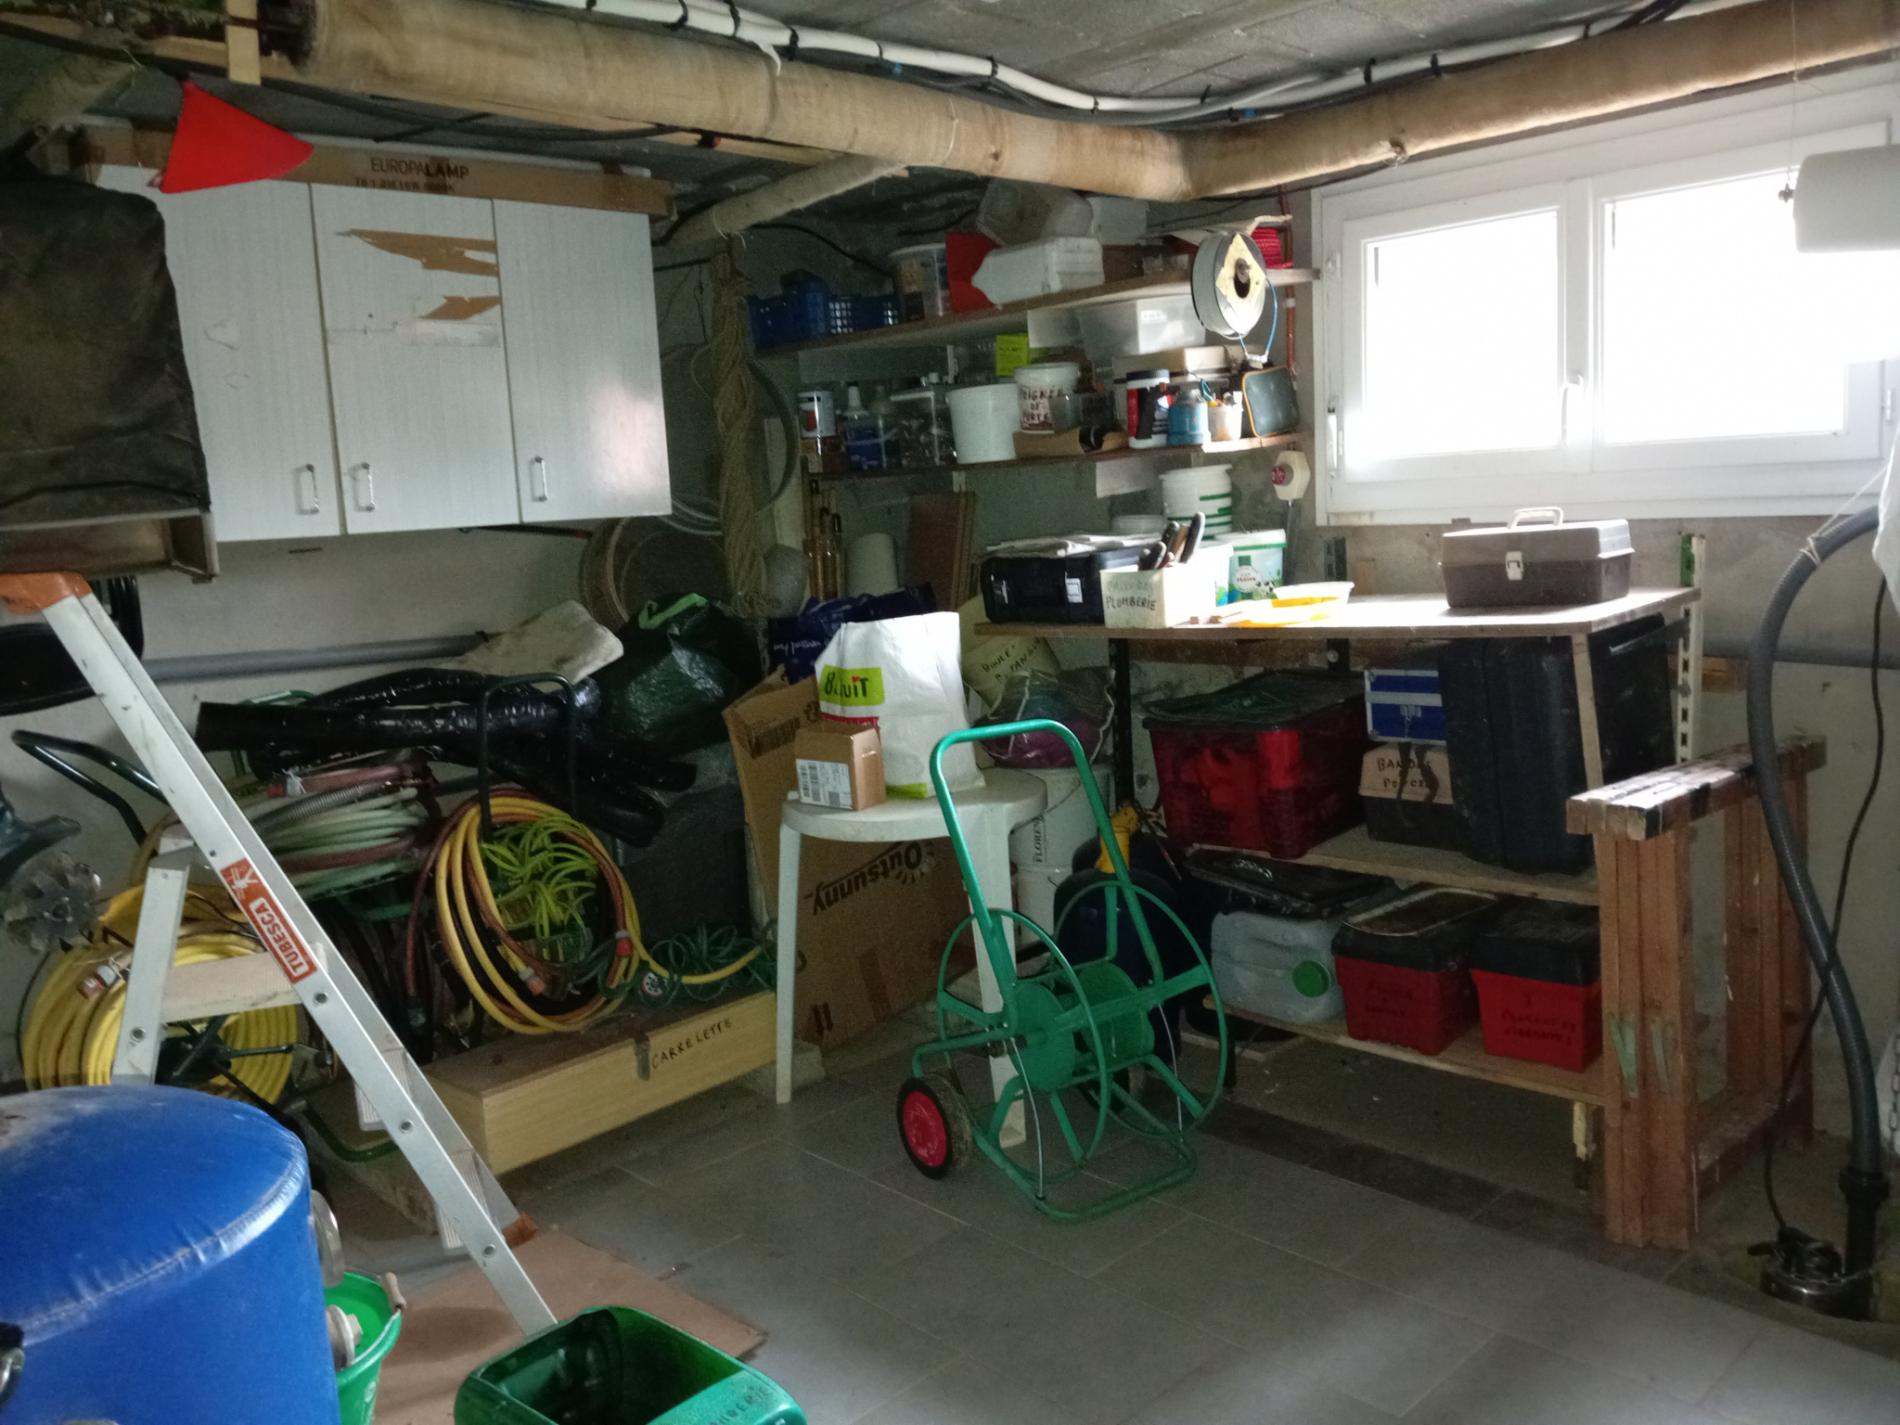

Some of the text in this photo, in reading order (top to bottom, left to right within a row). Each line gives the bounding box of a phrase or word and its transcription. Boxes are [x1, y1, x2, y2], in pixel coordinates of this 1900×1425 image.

[370, 157, 470, 179] EUROPALAMP
[1106, 594, 1157, 611] PLOMBERIE
[813, 841, 922, 916] Outsunny
[254, 902, 304, 975] TUBESCA
